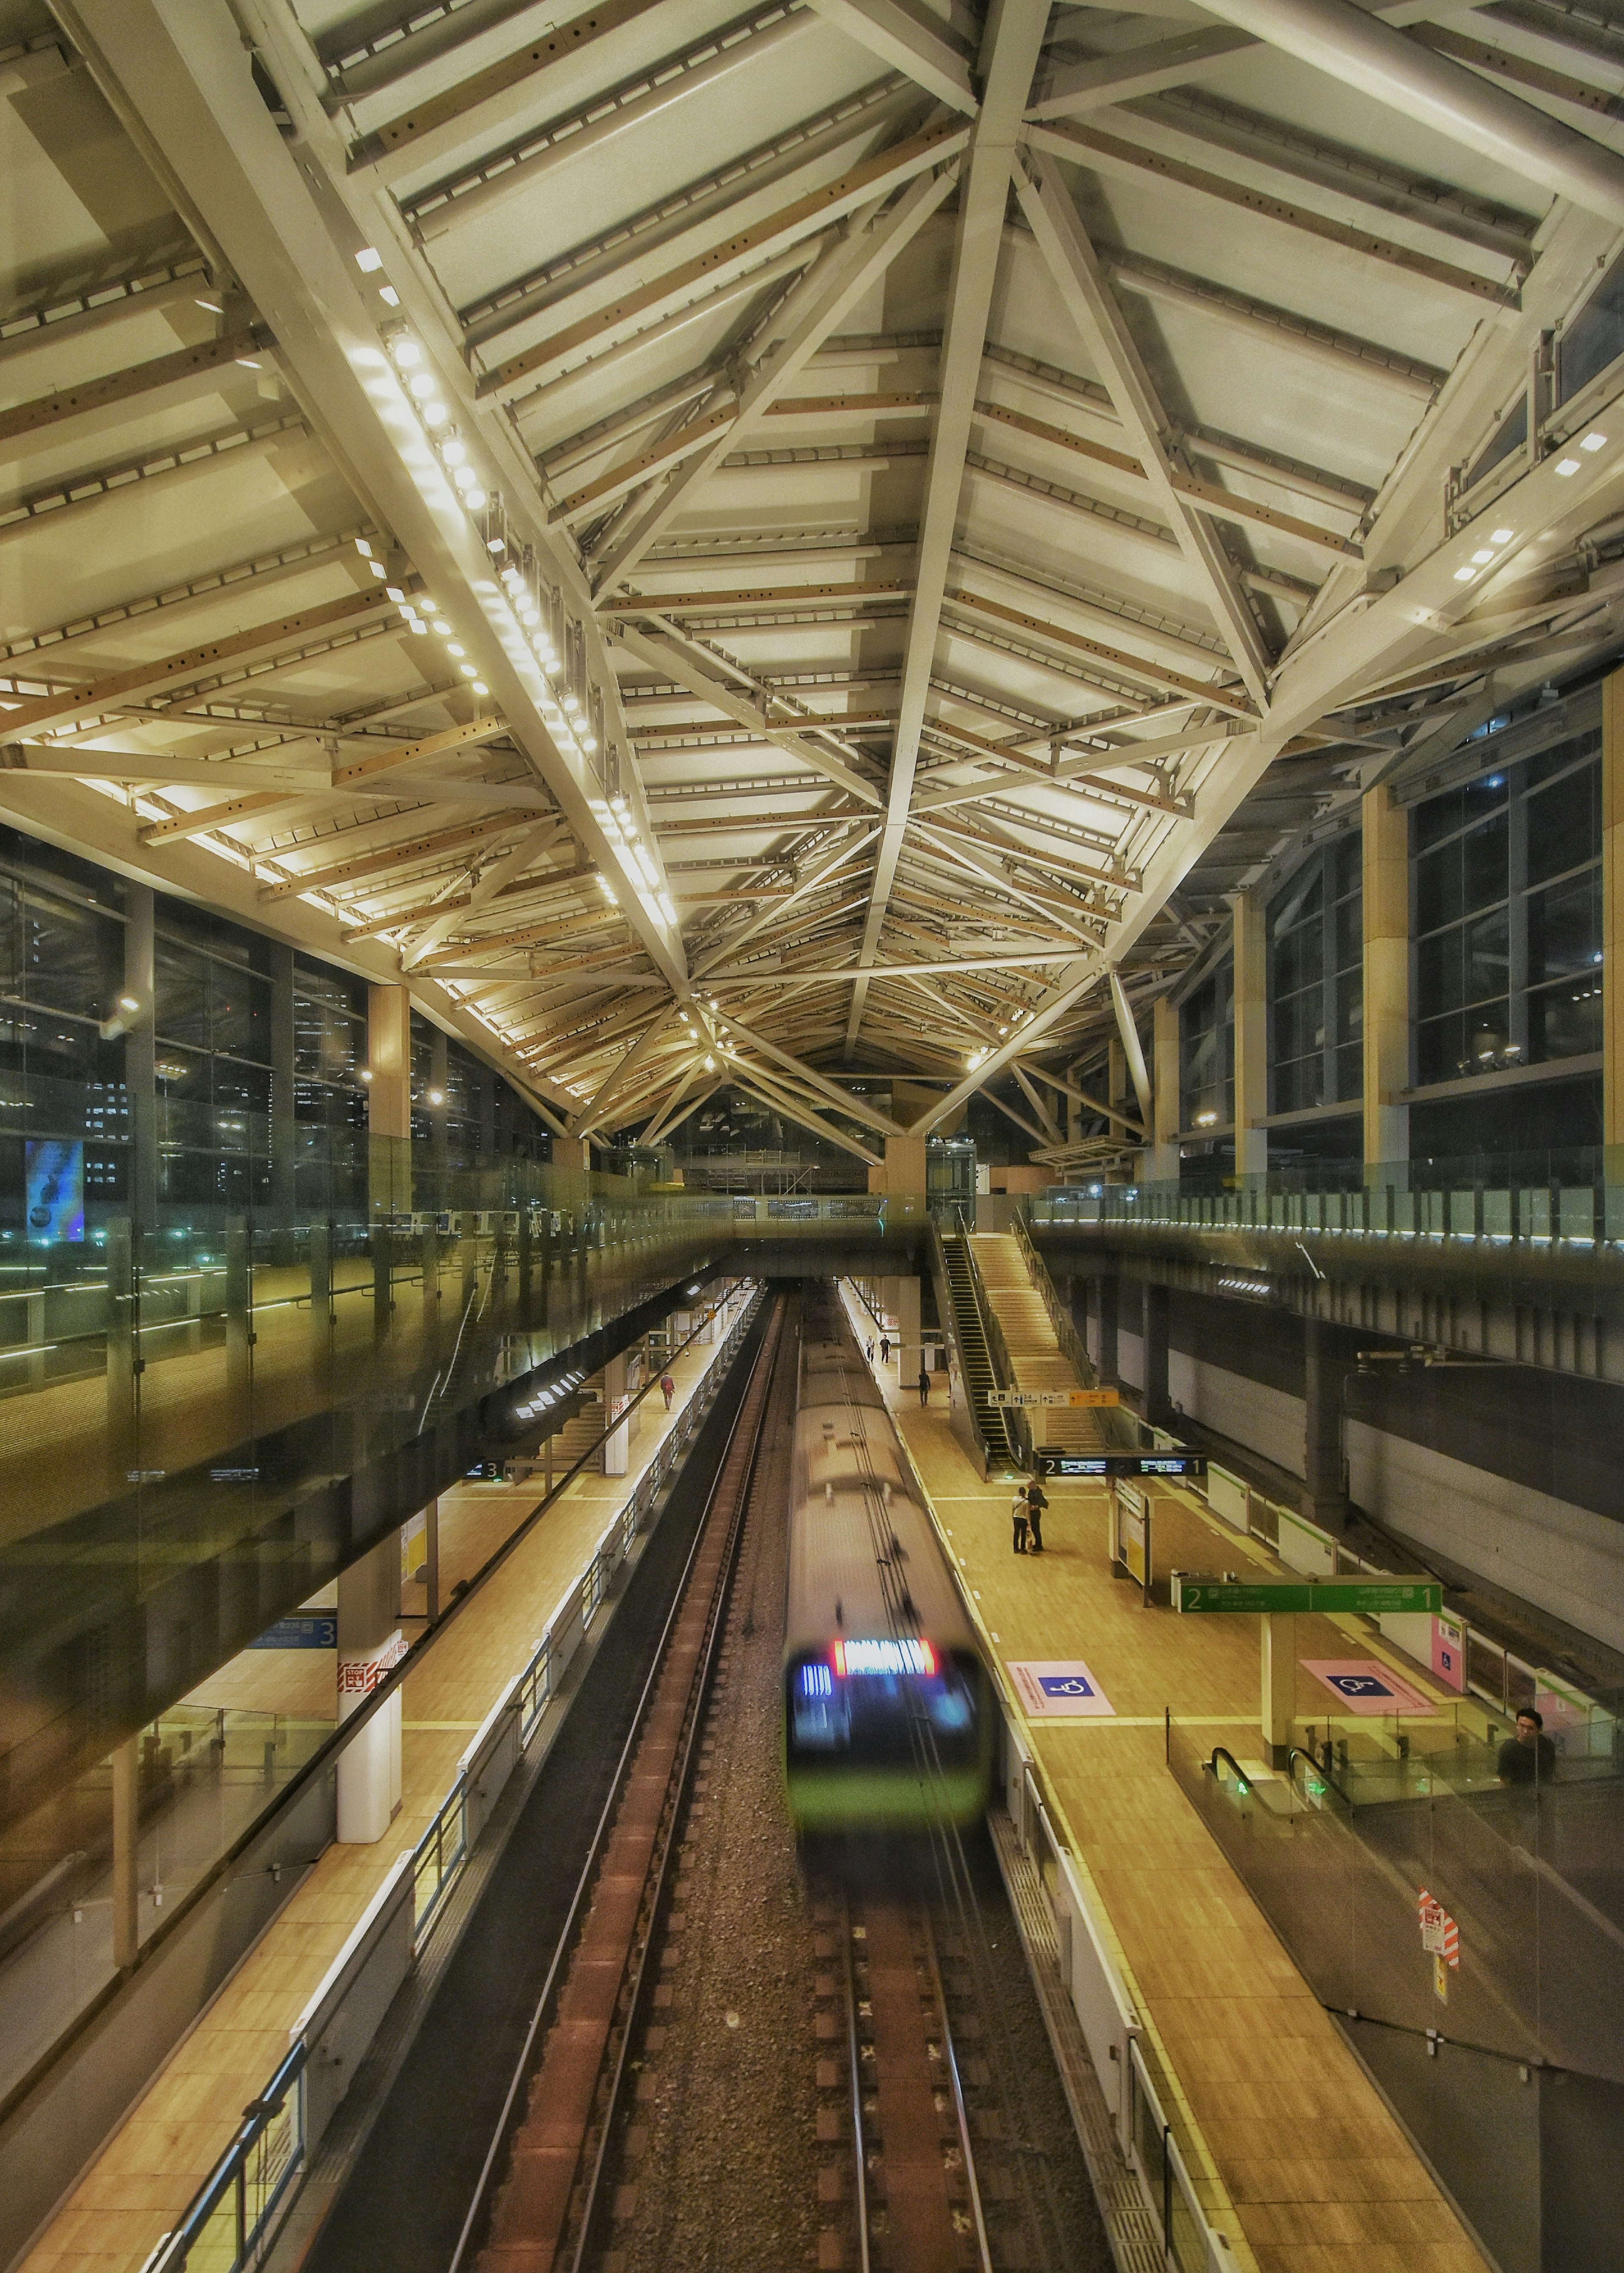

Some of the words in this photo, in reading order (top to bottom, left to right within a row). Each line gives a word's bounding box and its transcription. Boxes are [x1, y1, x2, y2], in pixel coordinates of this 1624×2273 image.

[487, 1462, 497, 1478] 3
[1046, 1459, 1056, 1474] 2
[1192, 1460, 1199, 1474] 1
[1188, 1588, 1202, 1609] 2
[1422, 1587, 1431, 1608] 1
[320, 1622, 335, 1645] 3
